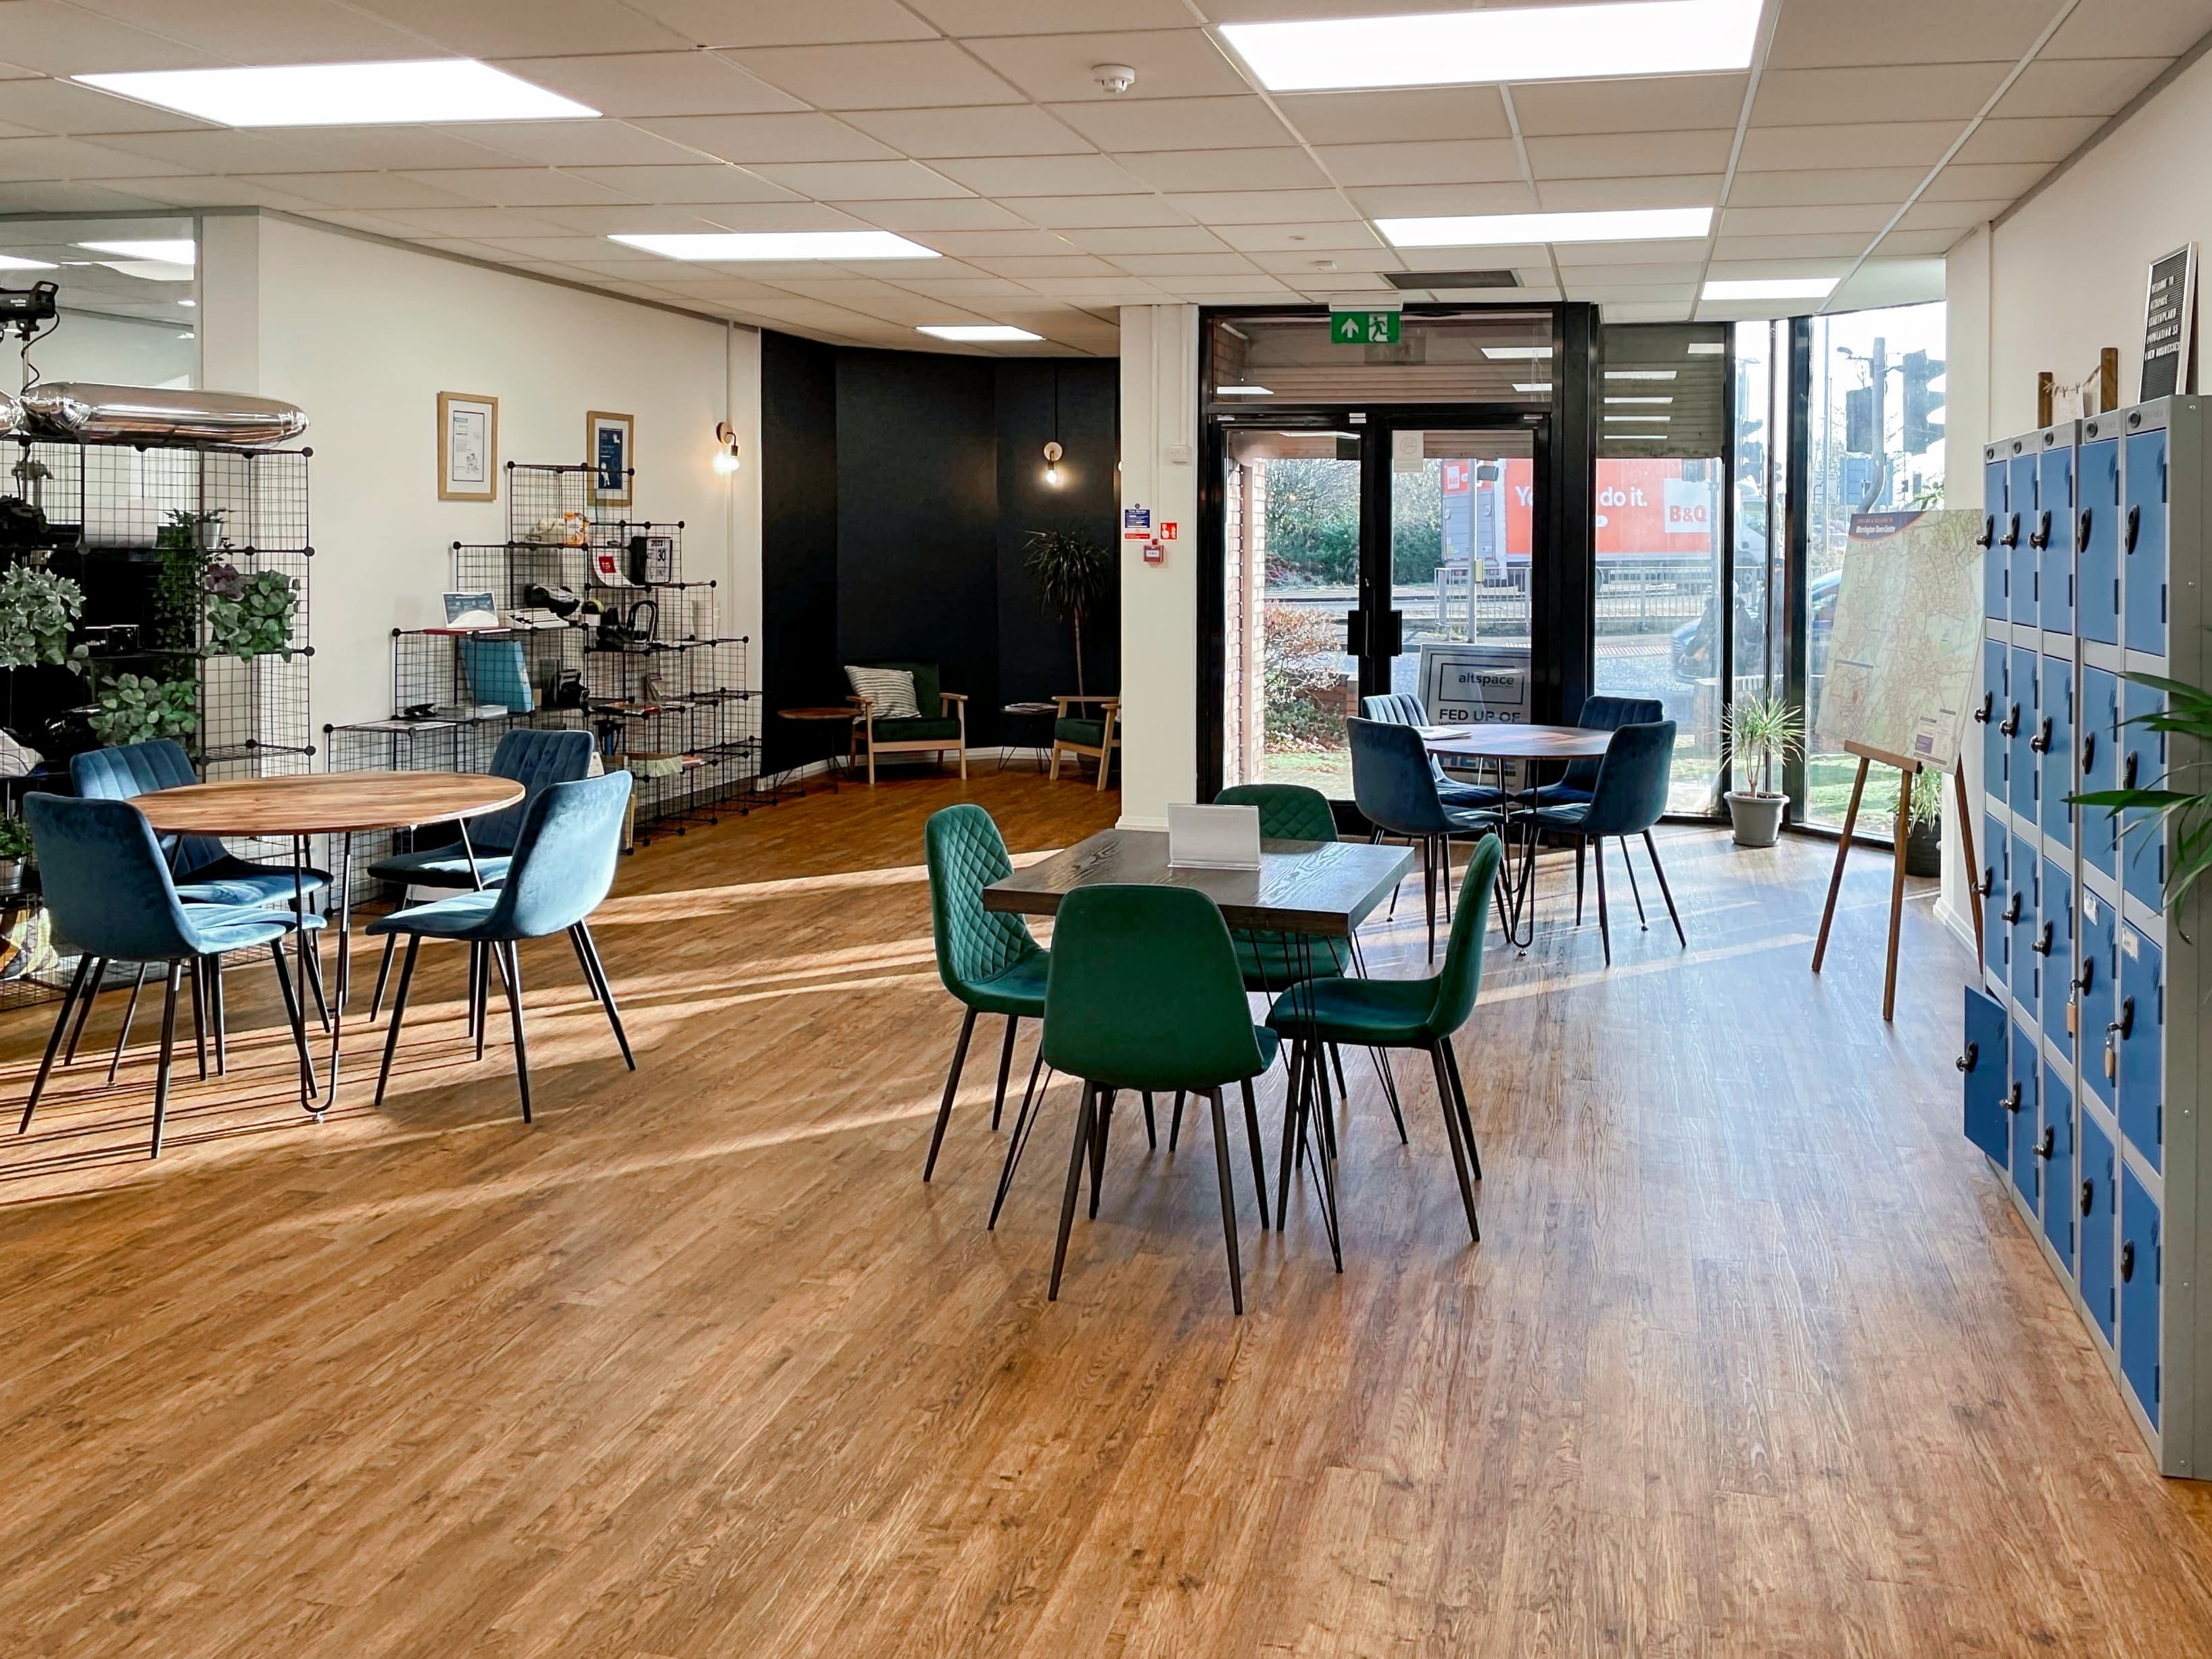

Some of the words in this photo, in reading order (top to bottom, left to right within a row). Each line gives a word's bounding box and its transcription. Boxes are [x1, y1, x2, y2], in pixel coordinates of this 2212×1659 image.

[1600, 486, 1626, 506] do
[1631, 486, 1648, 506] it.
[1669, 504, 1707, 523] B&Q
[657, 549, 666, 562] 30
[1458, 673, 1514, 687] altspace
[1439, 708, 1469, 721] FED
[1473, 710, 1495, 722] UP
[1499, 711, 1521, 723] OF
